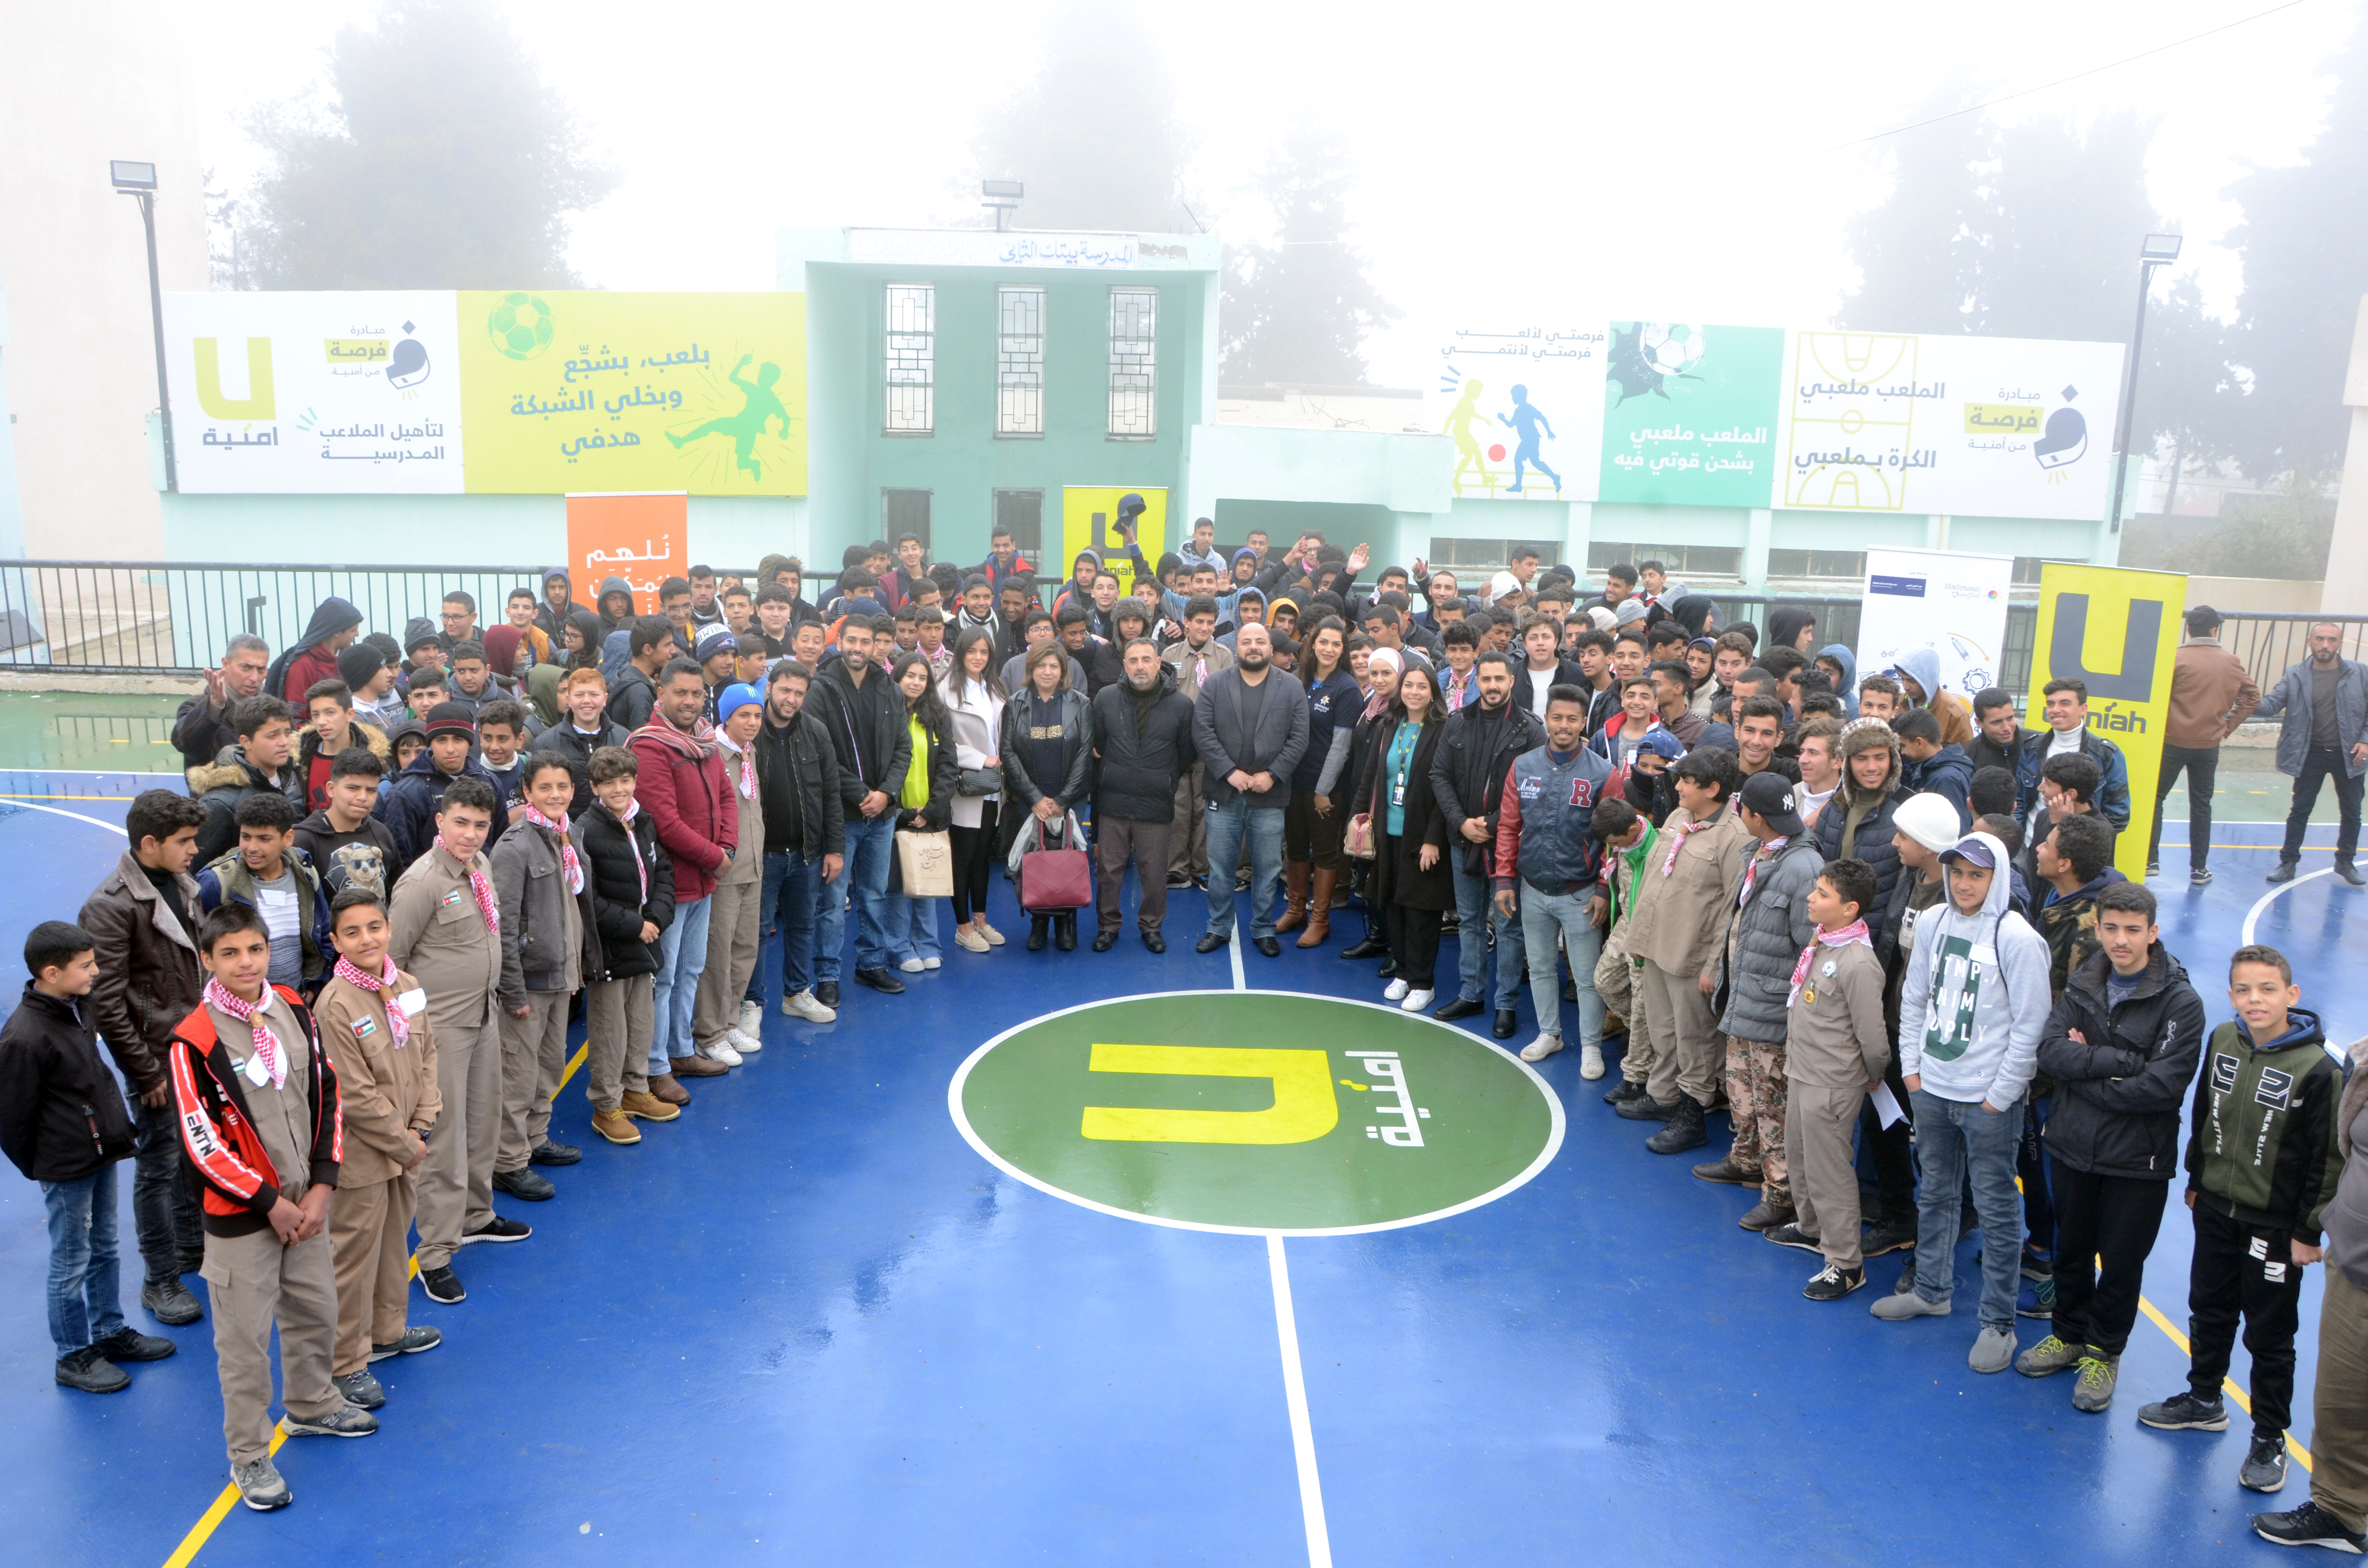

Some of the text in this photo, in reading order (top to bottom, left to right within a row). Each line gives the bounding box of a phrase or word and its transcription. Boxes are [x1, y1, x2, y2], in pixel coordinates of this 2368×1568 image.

[350, 325, 385, 336] مبادرة
[1546, 329, 1604, 344] فرصتي
[330, 341, 386, 360] فرصة
[1533, 345, 1591, 362] فرصتي
[332, 365, 380, 377] من أمنية
[510, 384, 683, 420] وبخلي الشبكة
[1800, 379, 1946, 404] الملعب ملعبي
[1998, 388, 2040, 401] مبادرة
[320, 418, 443, 441] لتأهيل الملاعب
[1969, 407, 2038, 432] فرصة
[561, 428, 641, 464] هدفي
[1630, 424, 1767, 448] الملعب ملعبي
[1968, 437, 2026, 452] من أمنية
[321, 446, 444, 464] المدرسية
[1614, 449, 1754, 475] بشحن قوتي فيه
[1794, 447, 1936, 475] الكرة بملعبي
[1945, 583, 1980, 592] Madrasati
[1569, 778, 1591, 808] R
[2212, 1092, 2222, 1155] NEW STYLE
